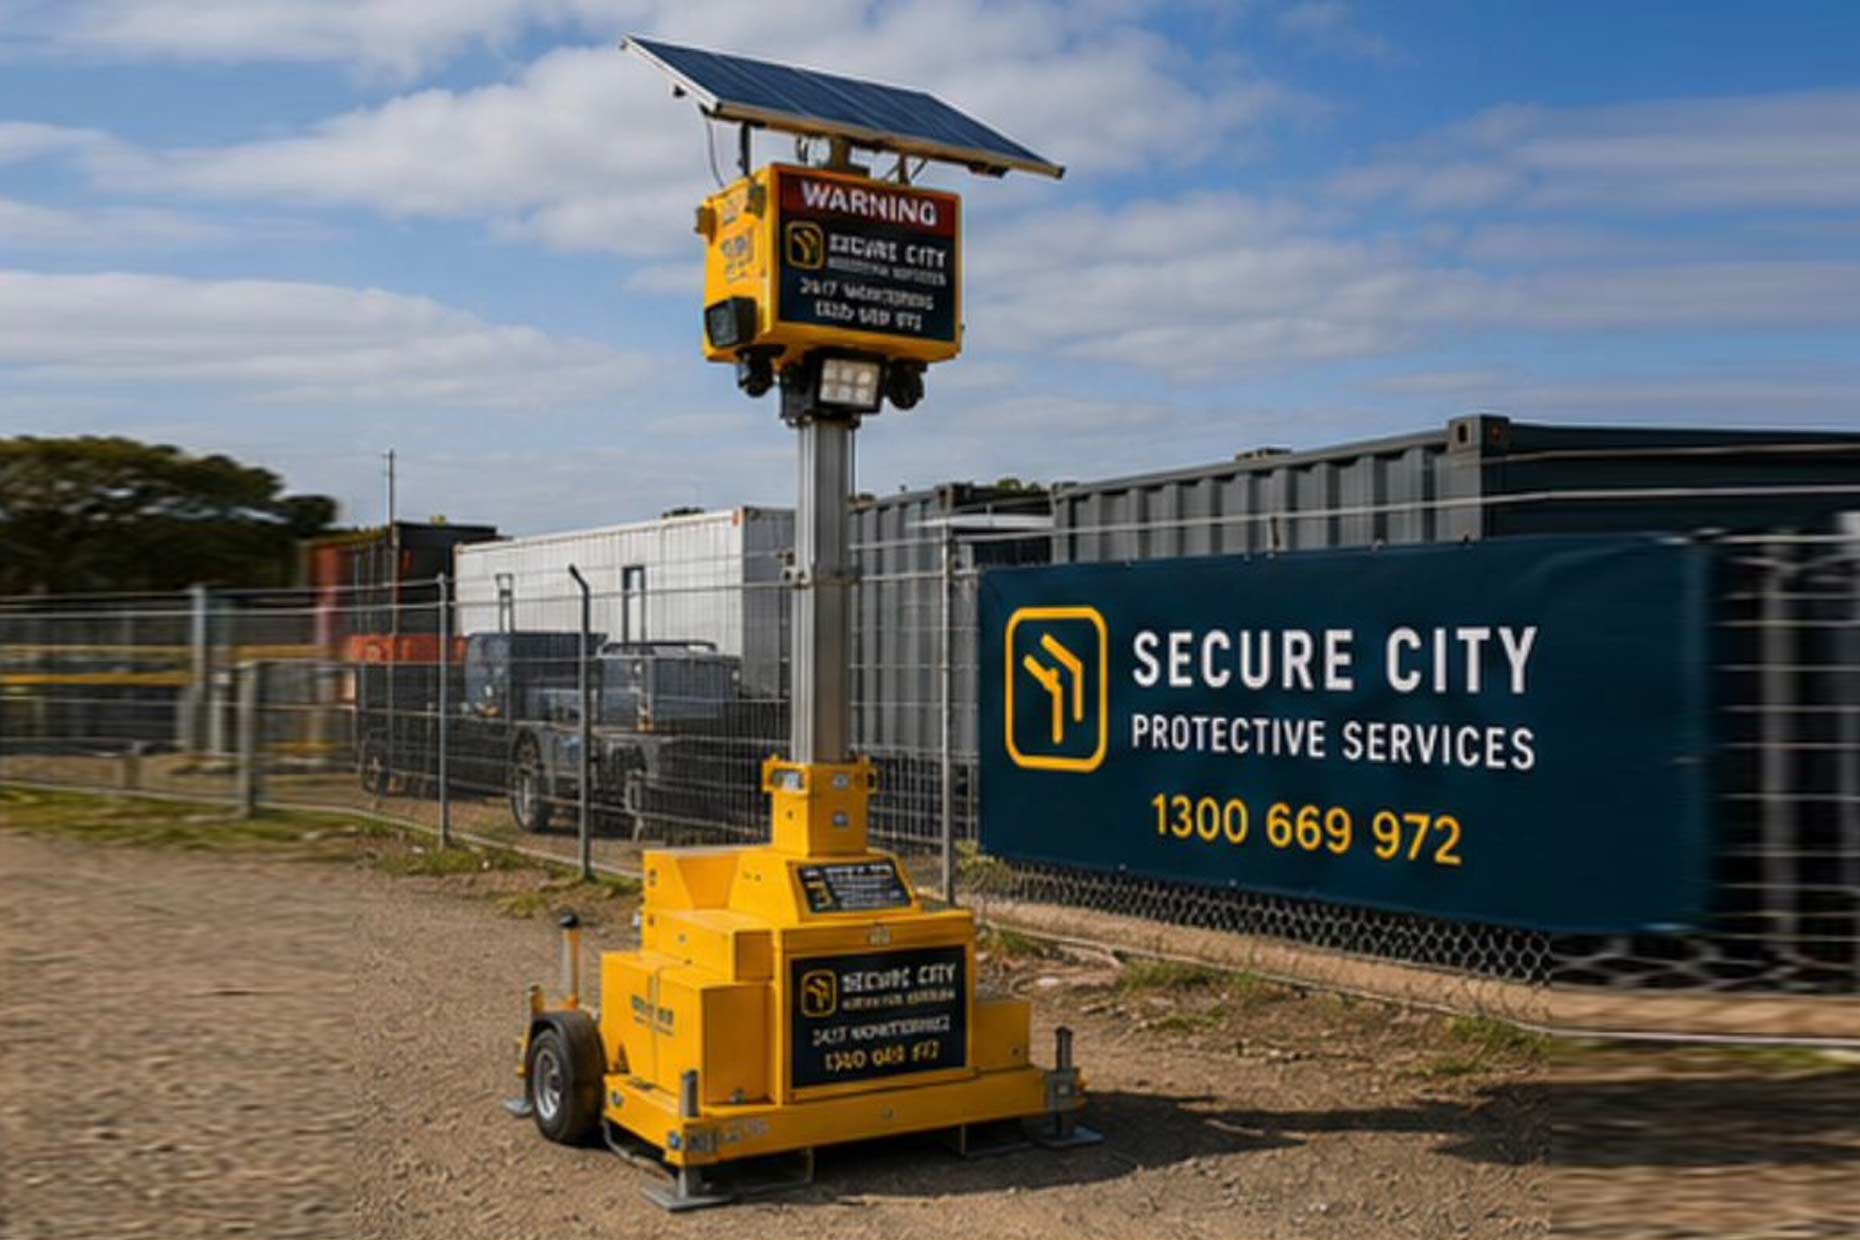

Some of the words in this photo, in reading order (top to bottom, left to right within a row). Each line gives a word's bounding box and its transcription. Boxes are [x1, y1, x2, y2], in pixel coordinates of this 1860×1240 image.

[801, 180, 937, 227] WARNING
[905, 246, 947, 268] CITY
[1132, 629, 1354, 692] SECURE
[1386, 626, 1538, 695] CITY
[1132, 714, 1326, 760] PROTECTIVE
[1343, 721, 1537, 771] SERVICES
[1152, 794, 1249, 844] 1300
[1266, 802, 1353, 855] 669
[1372, 811, 1463, 866] 972
